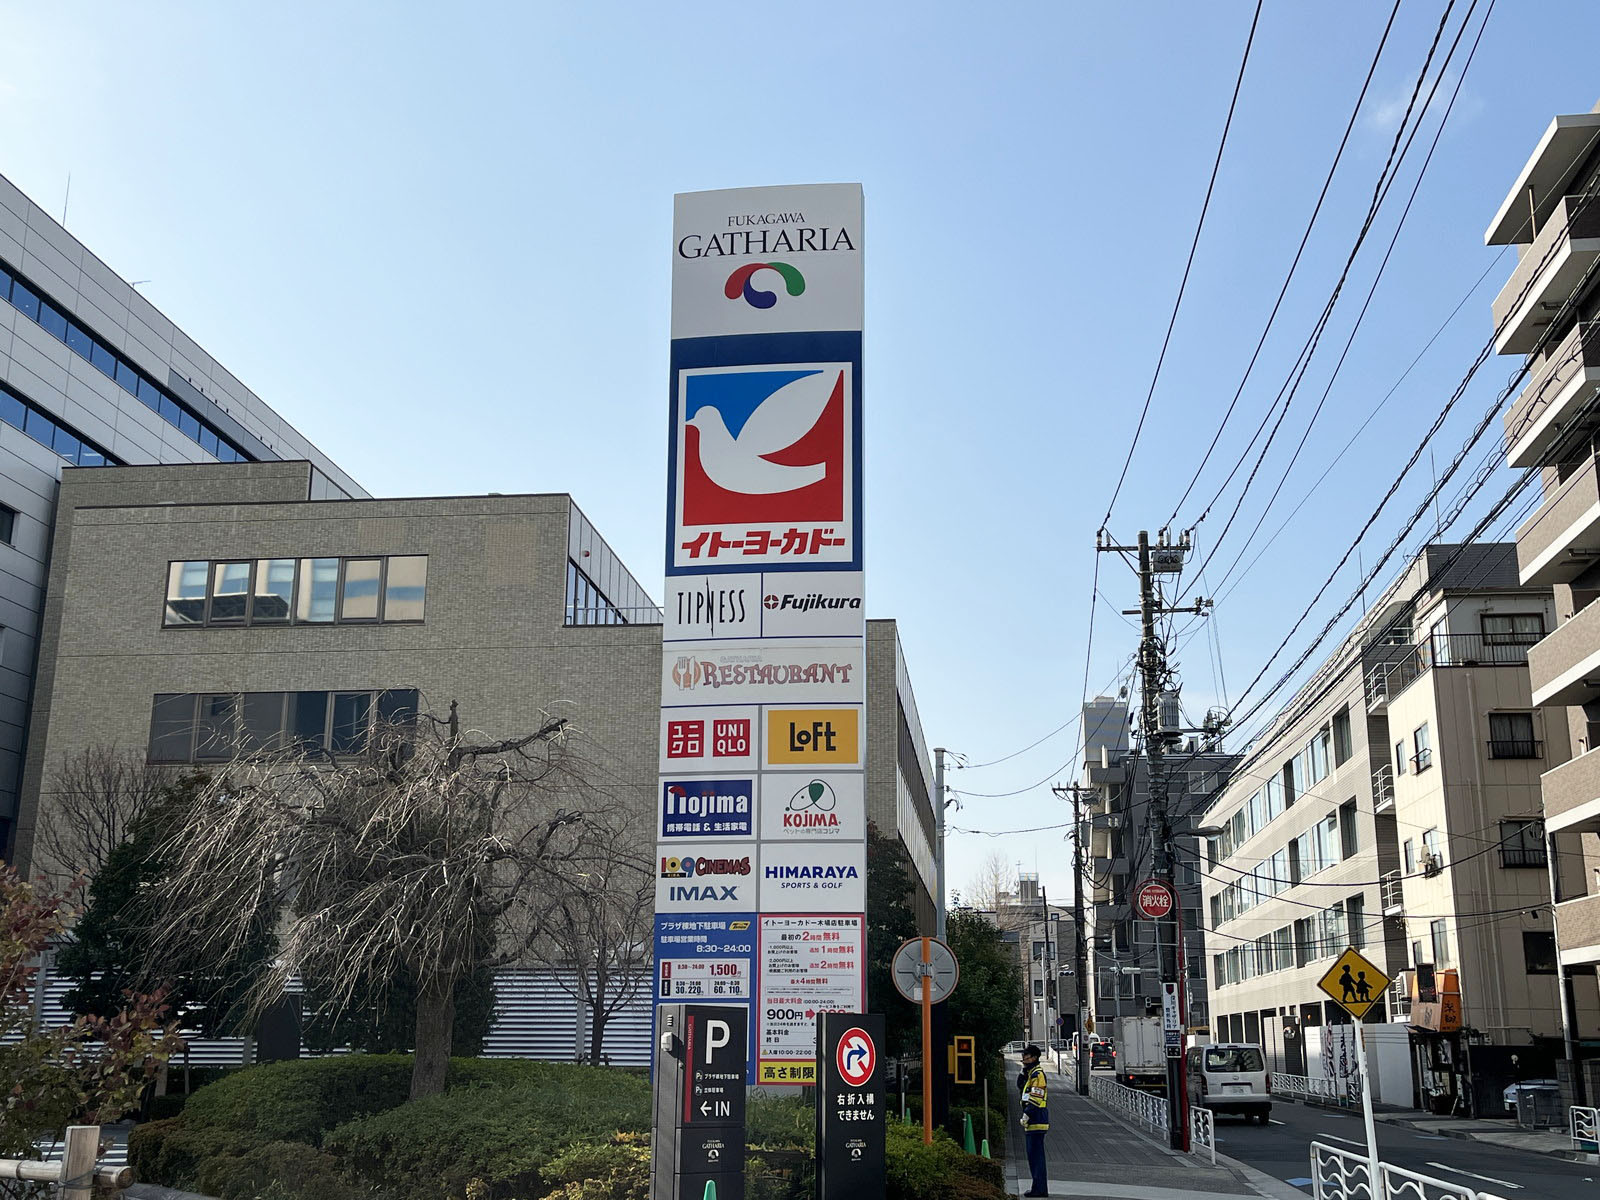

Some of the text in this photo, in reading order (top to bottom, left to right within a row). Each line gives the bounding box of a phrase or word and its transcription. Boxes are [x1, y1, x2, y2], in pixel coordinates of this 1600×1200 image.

[728, 212, 806, 227] FUKAGAWA
[678, 227, 857, 259] GATHARIA
[681, 528, 846, 559] イトーヨーカドー
[677, 577, 746, 637] TIPNESS
[780, 593, 862, 613] Fujikura
[667, 785, 748, 817] nojima
[783, 810, 839, 827] KOJIMA
[666, 821, 748, 832] 携帯電話 & 生活家電
[661, 856, 751, 878] 109 CINEMAS
[765, 866, 859, 879] HIMARAYA
[669, 886, 738, 901] IMAX
[1142, 894, 1169, 907] 消火栓
[763, 919, 858, 927] イトーヨーカドー木場店駐車場
[766, 1008, 803, 1020] 900円
[705, 1019, 731, 1065] P
[763, 1066, 815, 1080] 高さ制限
[836, 1093, 875, 1106] 右折入構
[715, 1100, 730, 1117] IN
[837, 1109, 875, 1121] できません
